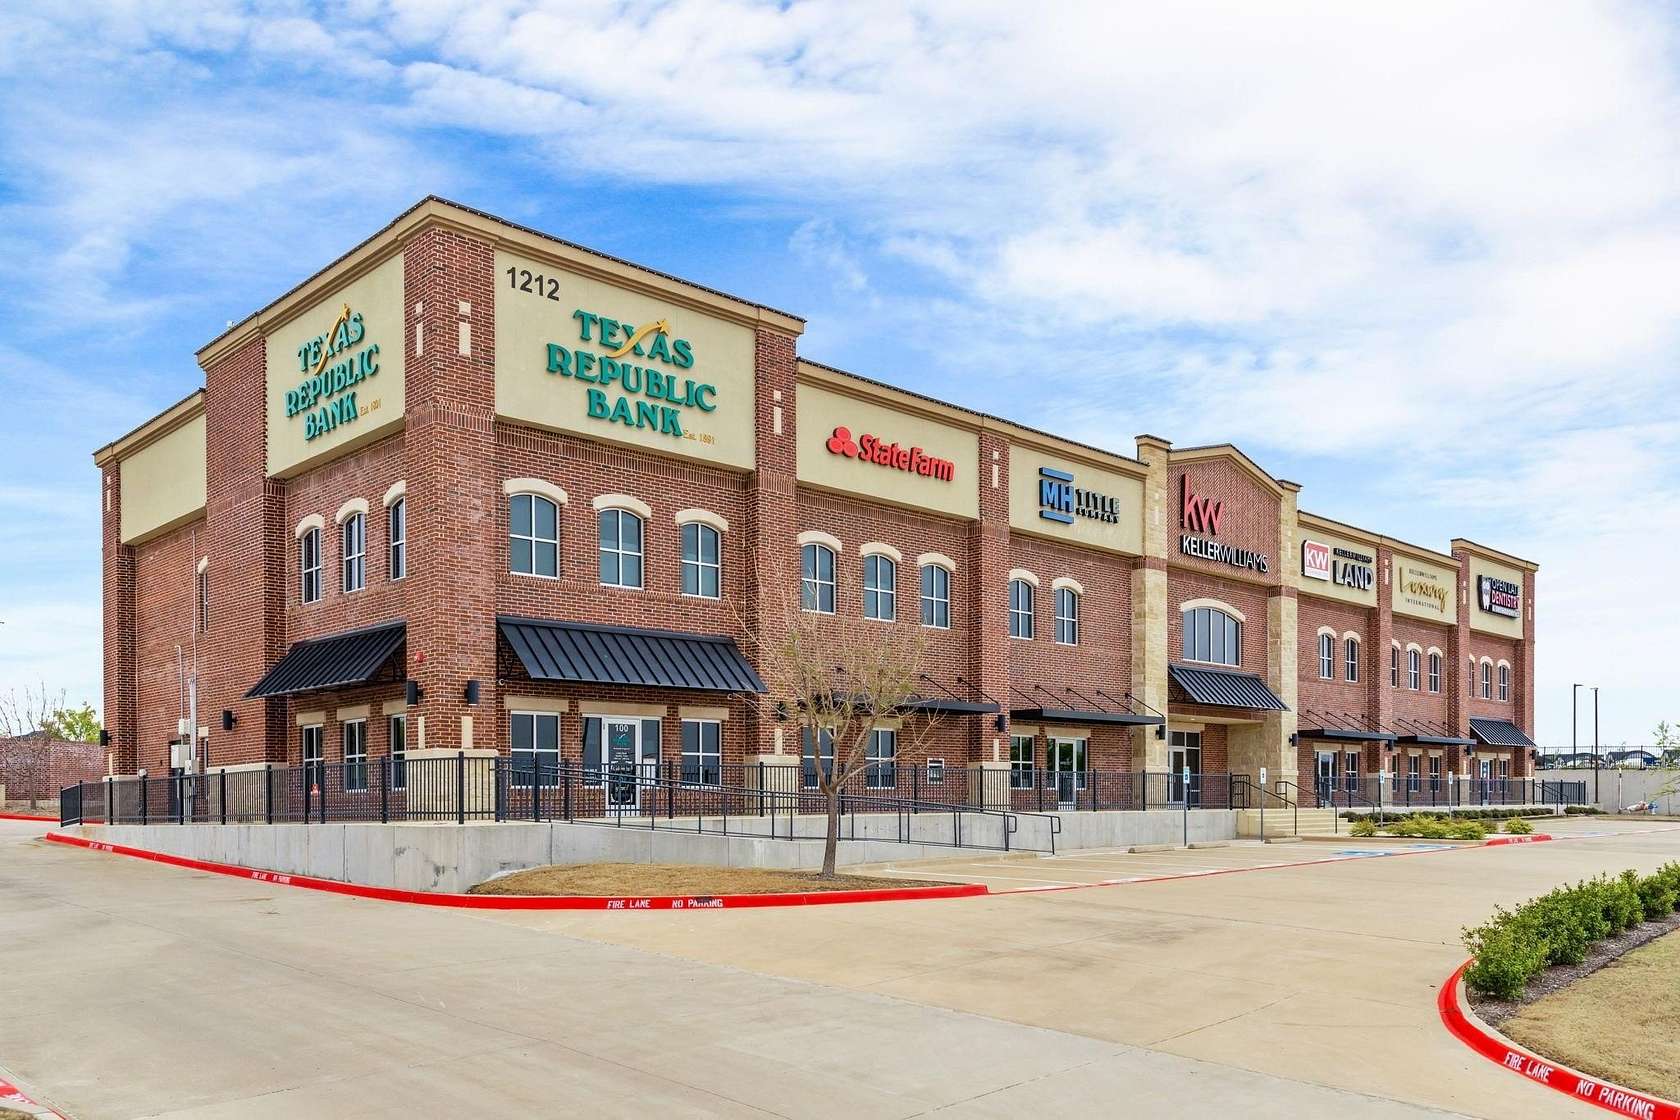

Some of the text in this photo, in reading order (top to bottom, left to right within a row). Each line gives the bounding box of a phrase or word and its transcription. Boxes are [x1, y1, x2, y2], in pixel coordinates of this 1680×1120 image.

[506, 266, 560, 301] 1212
[297, 312, 365, 372] TEXAS
[572, 309, 695, 369] TEXAS
[284, 343, 380, 418] REPUBLIC
[546, 342, 717, 412] REPUBLIC
[304, 391, 358, 441] BANK
[586, 387, 684, 437] BANK
[1039, 479, 1074, 513] MH
[1075, 488, 1120, 515] TITLE
[1305, 548, 1329, 570] KW
[1332, 559, 1374, 591] LAND
[1491, 577, 1508, 593] OPEN
[615, 724, 629, 732] 100
[607, 899, 626, 909] FIRE
[629, 899, 651, 908] LANE
[671, 899, 684, 908] NO
[1504, 1051, 1656, 1120] FIRE LANE NO PARKING
